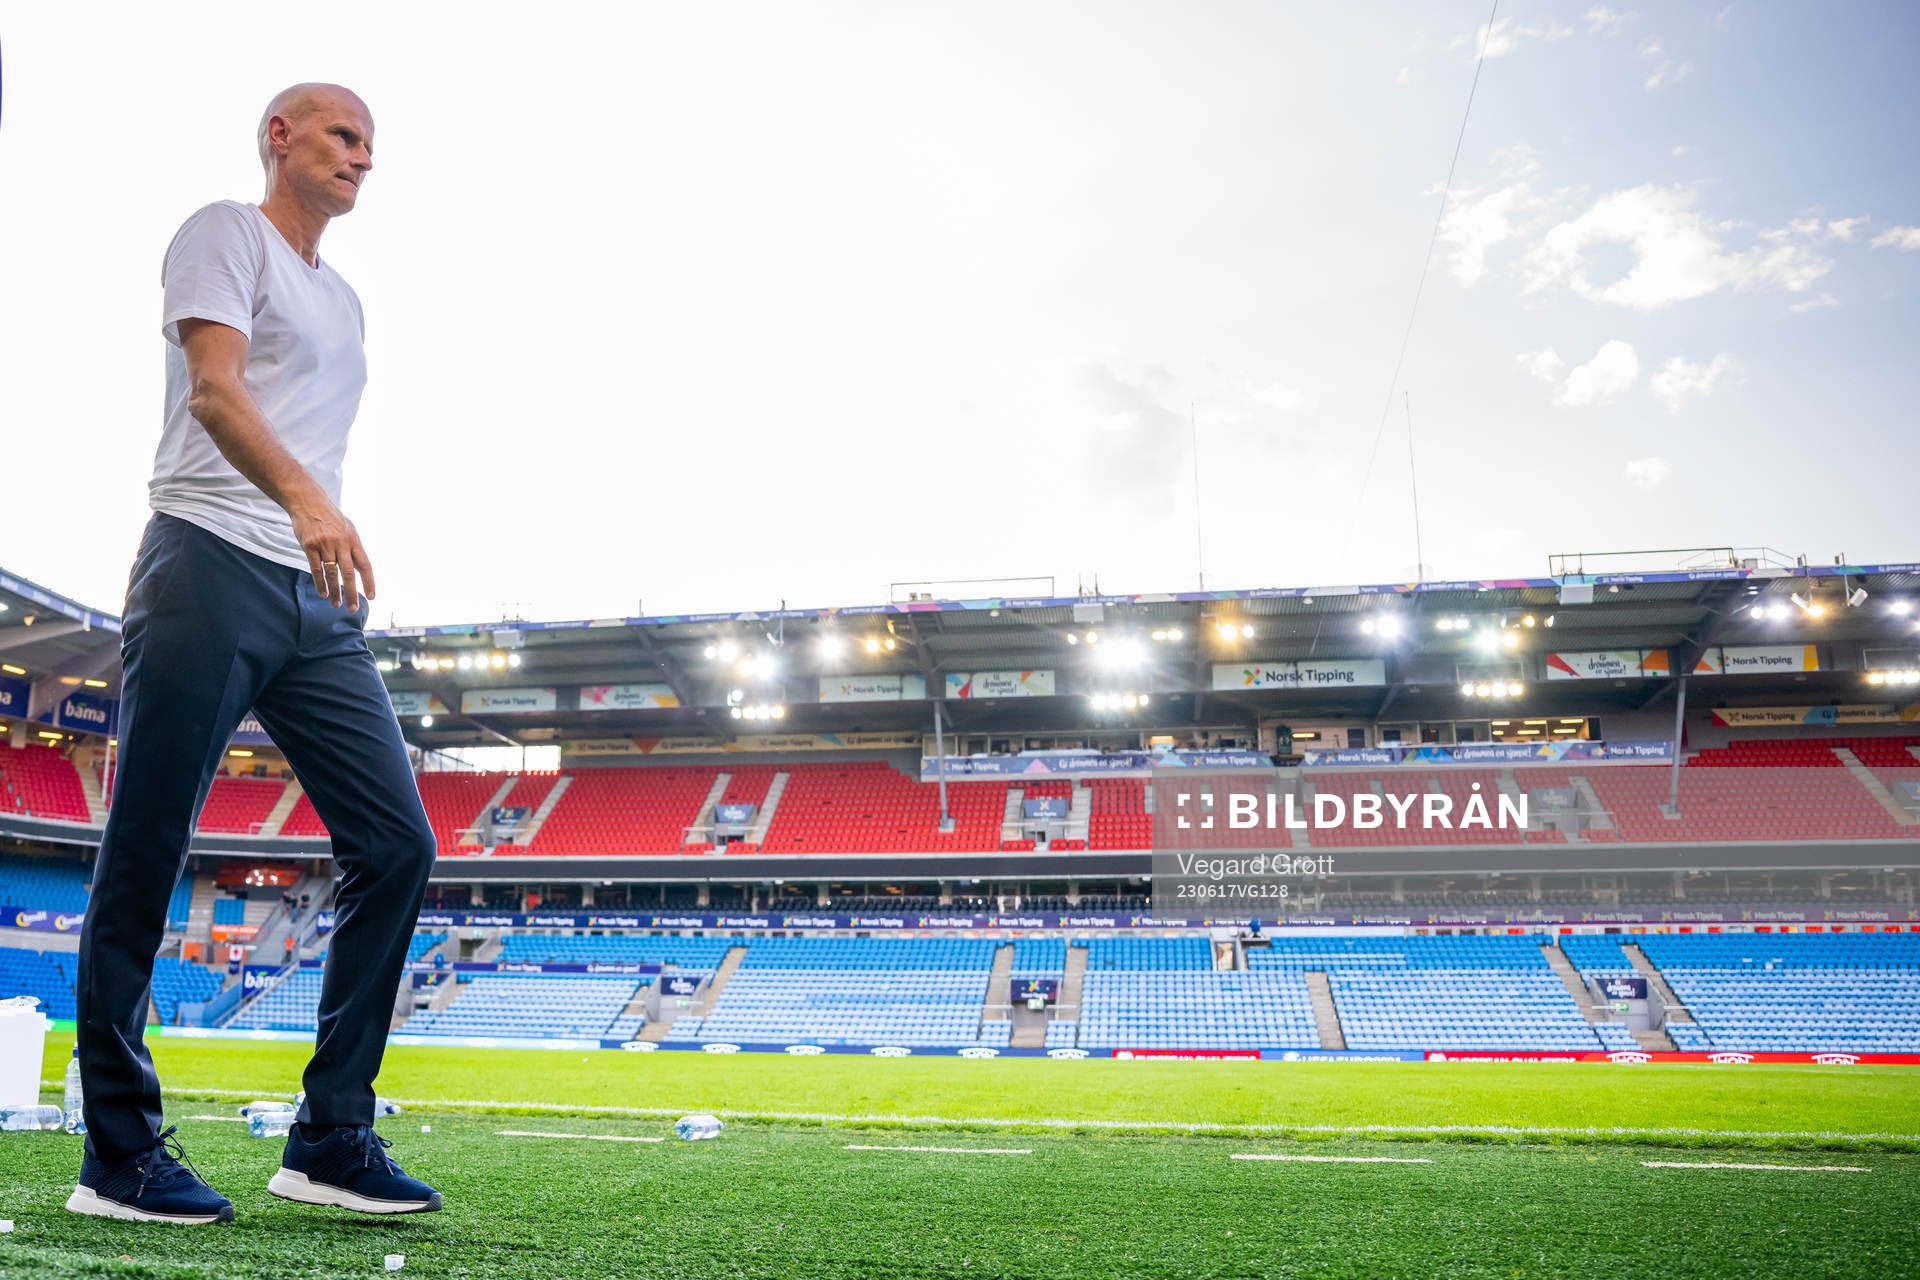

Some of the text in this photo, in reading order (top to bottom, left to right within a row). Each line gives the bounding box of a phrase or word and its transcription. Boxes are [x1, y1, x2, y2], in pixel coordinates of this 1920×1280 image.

[1732, 654, 1795, 669] Norsk Tipping
[1266, 668, 1355, 685] Norsk Tipping
[854, 683, 904, 695] Norsk Tipping
[65, 700, 106, 724] bama
[1610, 745, 1665, 757] Norsk Tipping
[1206, 755, 1257, 767] Norsk Tipping
[1337, 751, 1390, 765] Norsk Tipping
[951, 761, 1000, 773] Norsk Tipping
[1070, 917, 1115, 927] Norsk Tipping
[1142, 916, 1187, 926] Norsk Tipping
[1594, 913, 1643, 924] Norsk Tipping
[1674, 911, 1723, 923] Norsk Tipping
[1754, 911, 1805, 922] Norsk Tipping
[1837, 910, 1888, 922] Norsk Tipping
[999, 917, 1043, 928] Norsk Tipping
[1608, 1053, 1650, 1063] THON
[1709, 1054, 1751, 1064] THON
[1813, 1055, 1857, 1065] THON
